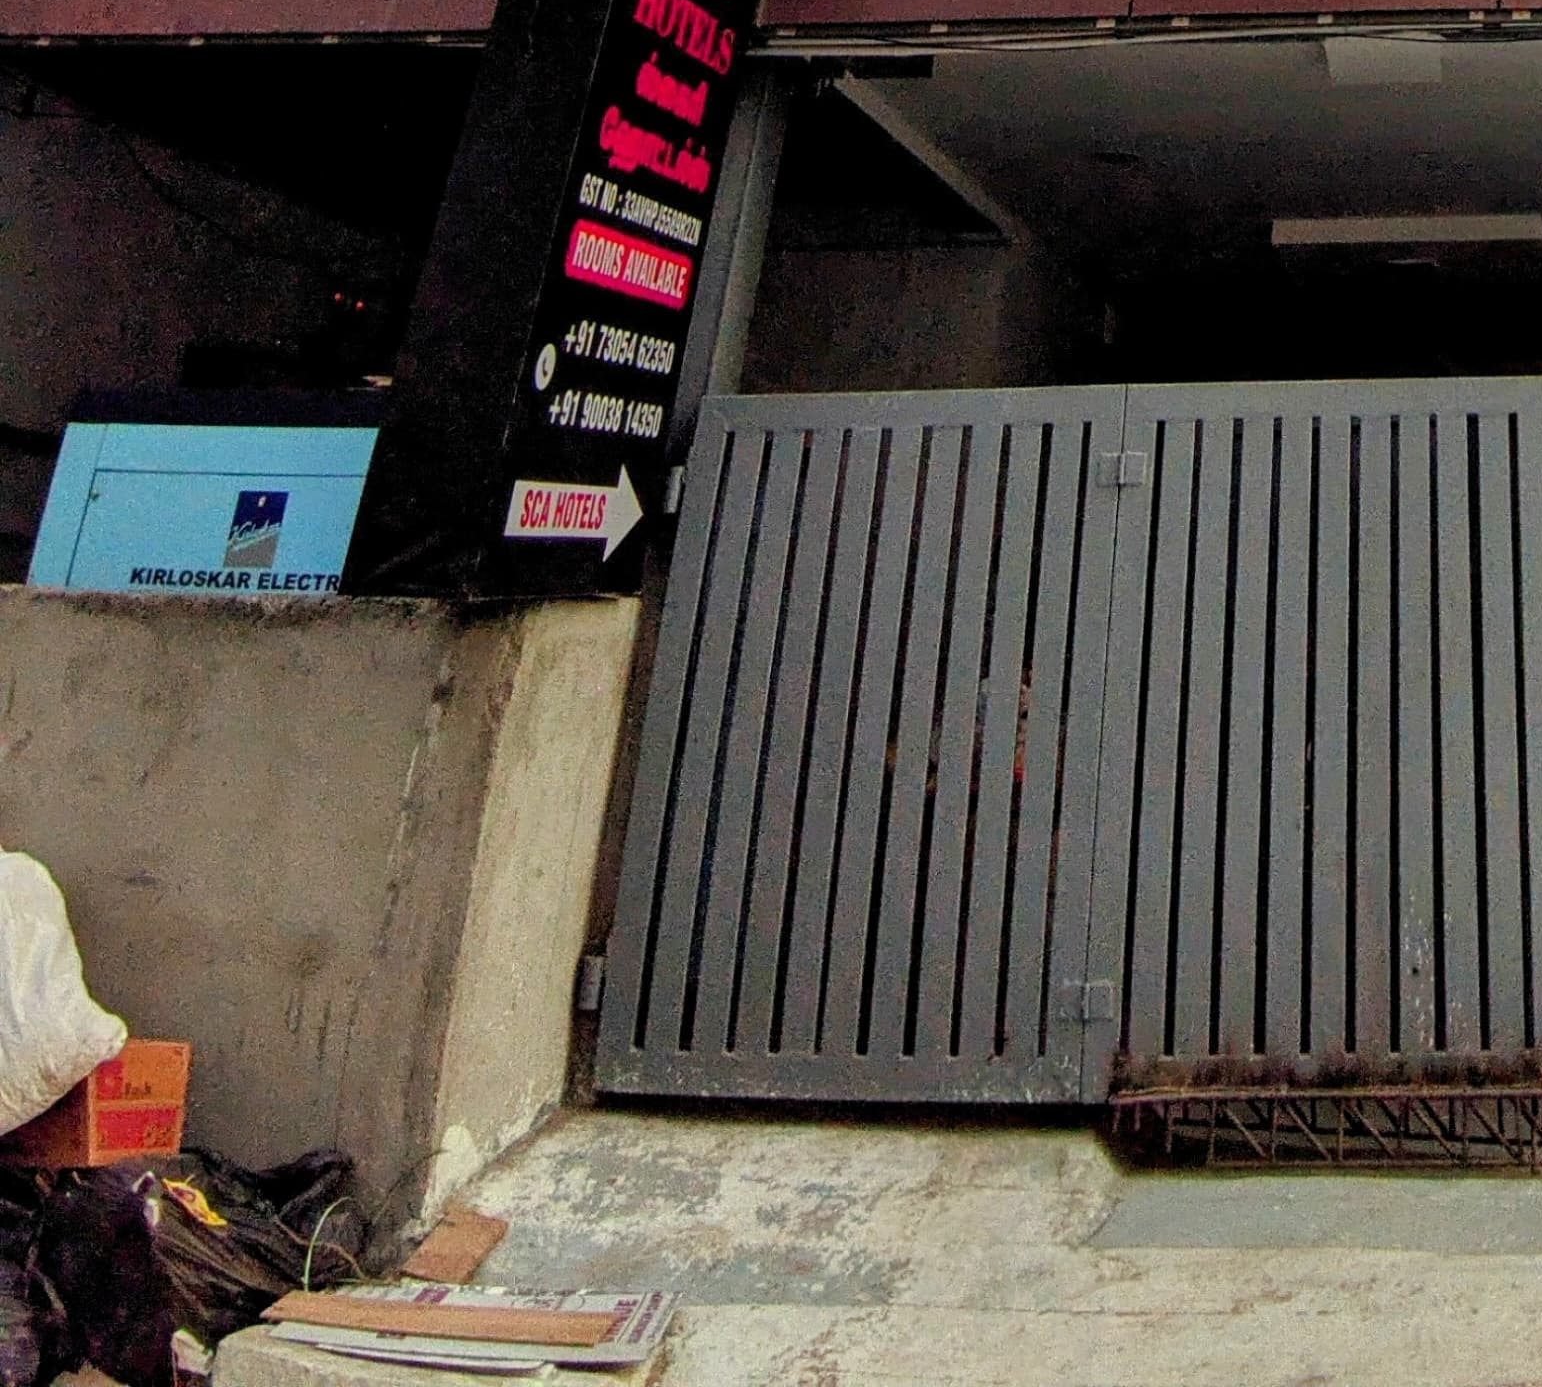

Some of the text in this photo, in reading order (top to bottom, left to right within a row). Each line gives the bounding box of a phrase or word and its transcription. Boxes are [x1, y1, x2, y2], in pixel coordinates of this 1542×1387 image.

[579, 173, 603, 208] GST
[600, 180, 618, 214] NO
[572, 231, 688, 299] ROOMS AVAILABLE
[564, 320, 676, 375] +91 73054 62350
[548, 389, 663, 438] +91 90038 14350
[520, 489, 607, 531] SCA HOTELS
[129, 567, 340, 591] KIRLOSKAR ELECTR
